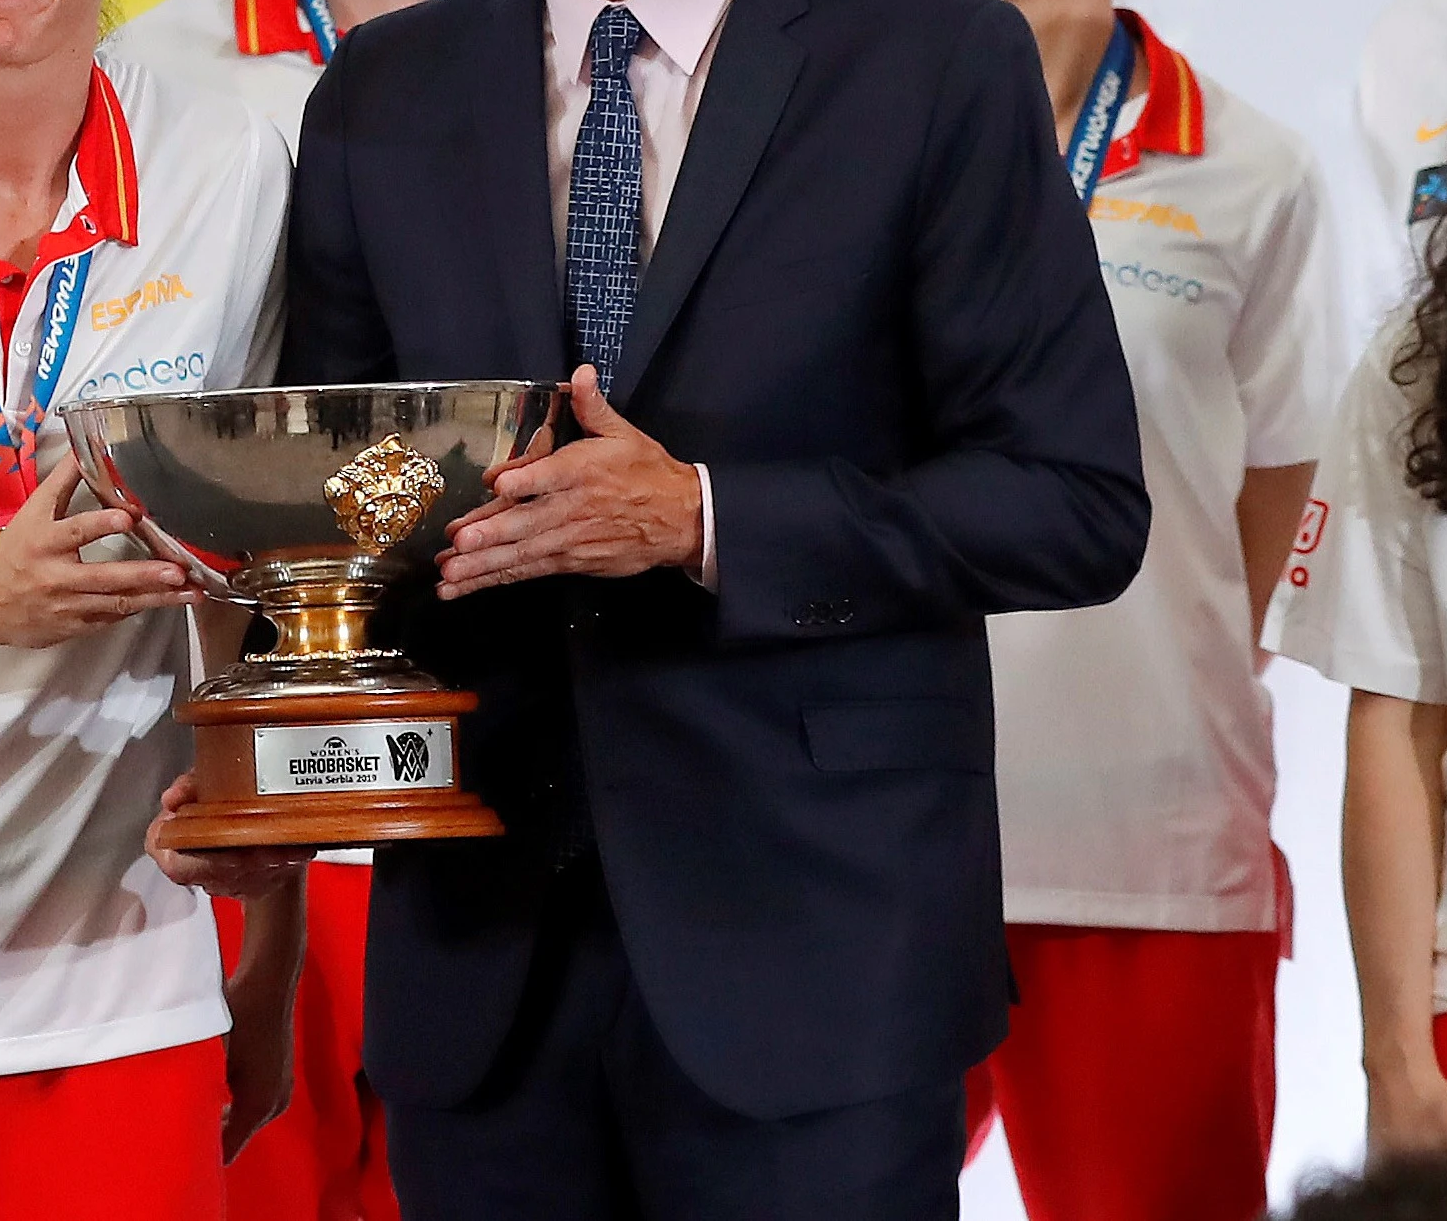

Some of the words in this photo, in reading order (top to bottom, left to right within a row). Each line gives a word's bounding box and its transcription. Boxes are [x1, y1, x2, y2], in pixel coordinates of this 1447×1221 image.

[91, 273, 195, 332] ESPAÑA
[76, 351, 206, 402] endesa
[309, 748, 360, 758] WOMEN'S
[289, 756, 381, 775] EUROBASKET
[295, 776, 323, 786] Latvia
[325, 774, 353, 784] Serbia
[356, 774, 378, 783] 2019
